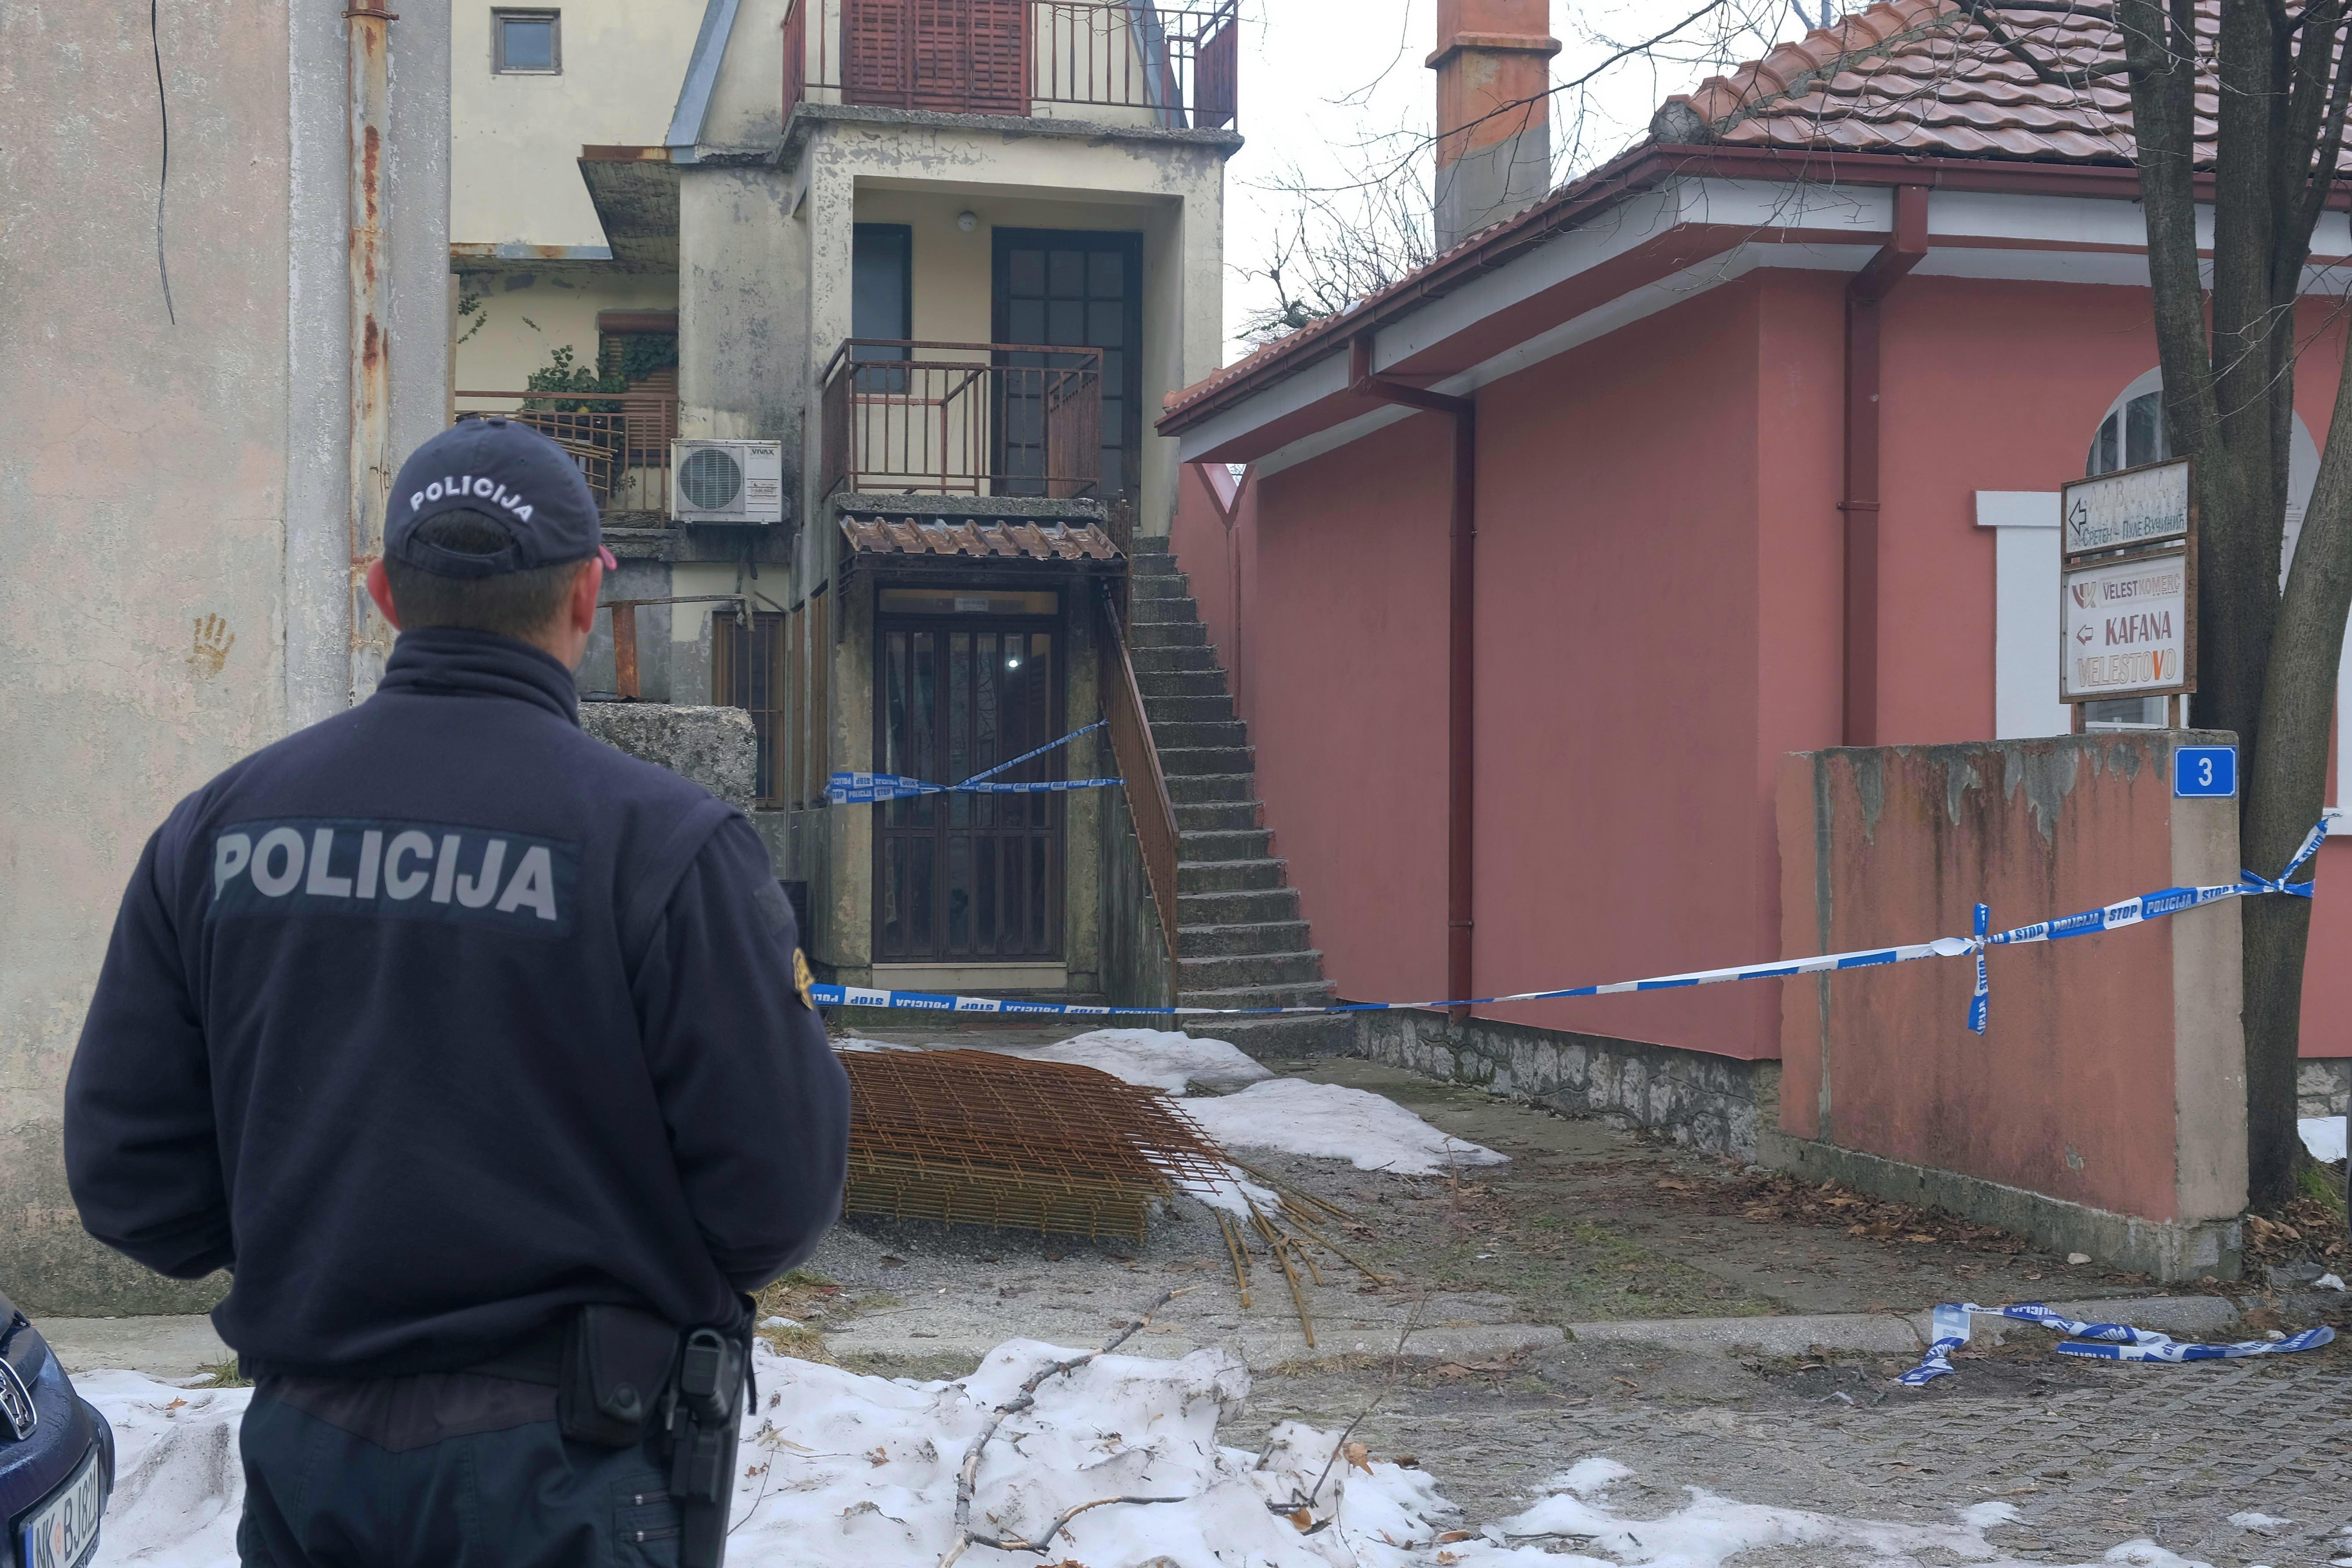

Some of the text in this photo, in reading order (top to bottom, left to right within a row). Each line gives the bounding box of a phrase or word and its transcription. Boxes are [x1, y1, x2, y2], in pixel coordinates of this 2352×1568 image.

[410, 475, 534, 523] POLICIJA
[2082, 527, 2112, 547] СРЕТЕН
[2106, 611, 2172, 646] KAFANA
[2078, 648, 2176, 687] VELESTOVO
[2198, 758, 2212, 786] 3
[214, 826, 557, 921] POLICIJA
[2015, 924, 2044, 940] STOP
[2053, 913, 2099, 932] POLICIJA
[2109, 905, 2138, 921] STOP
[2147, 894, 2192, 914] POLICIJA
[813, 993, 839, 1002] POLI
[850, 996, 884, 1005] STOP
[896, 999, 950, 1009] POLICIJA
[36, 1513, 55, 1568] NK
[65, 1464, 97, 1562] BJ821
